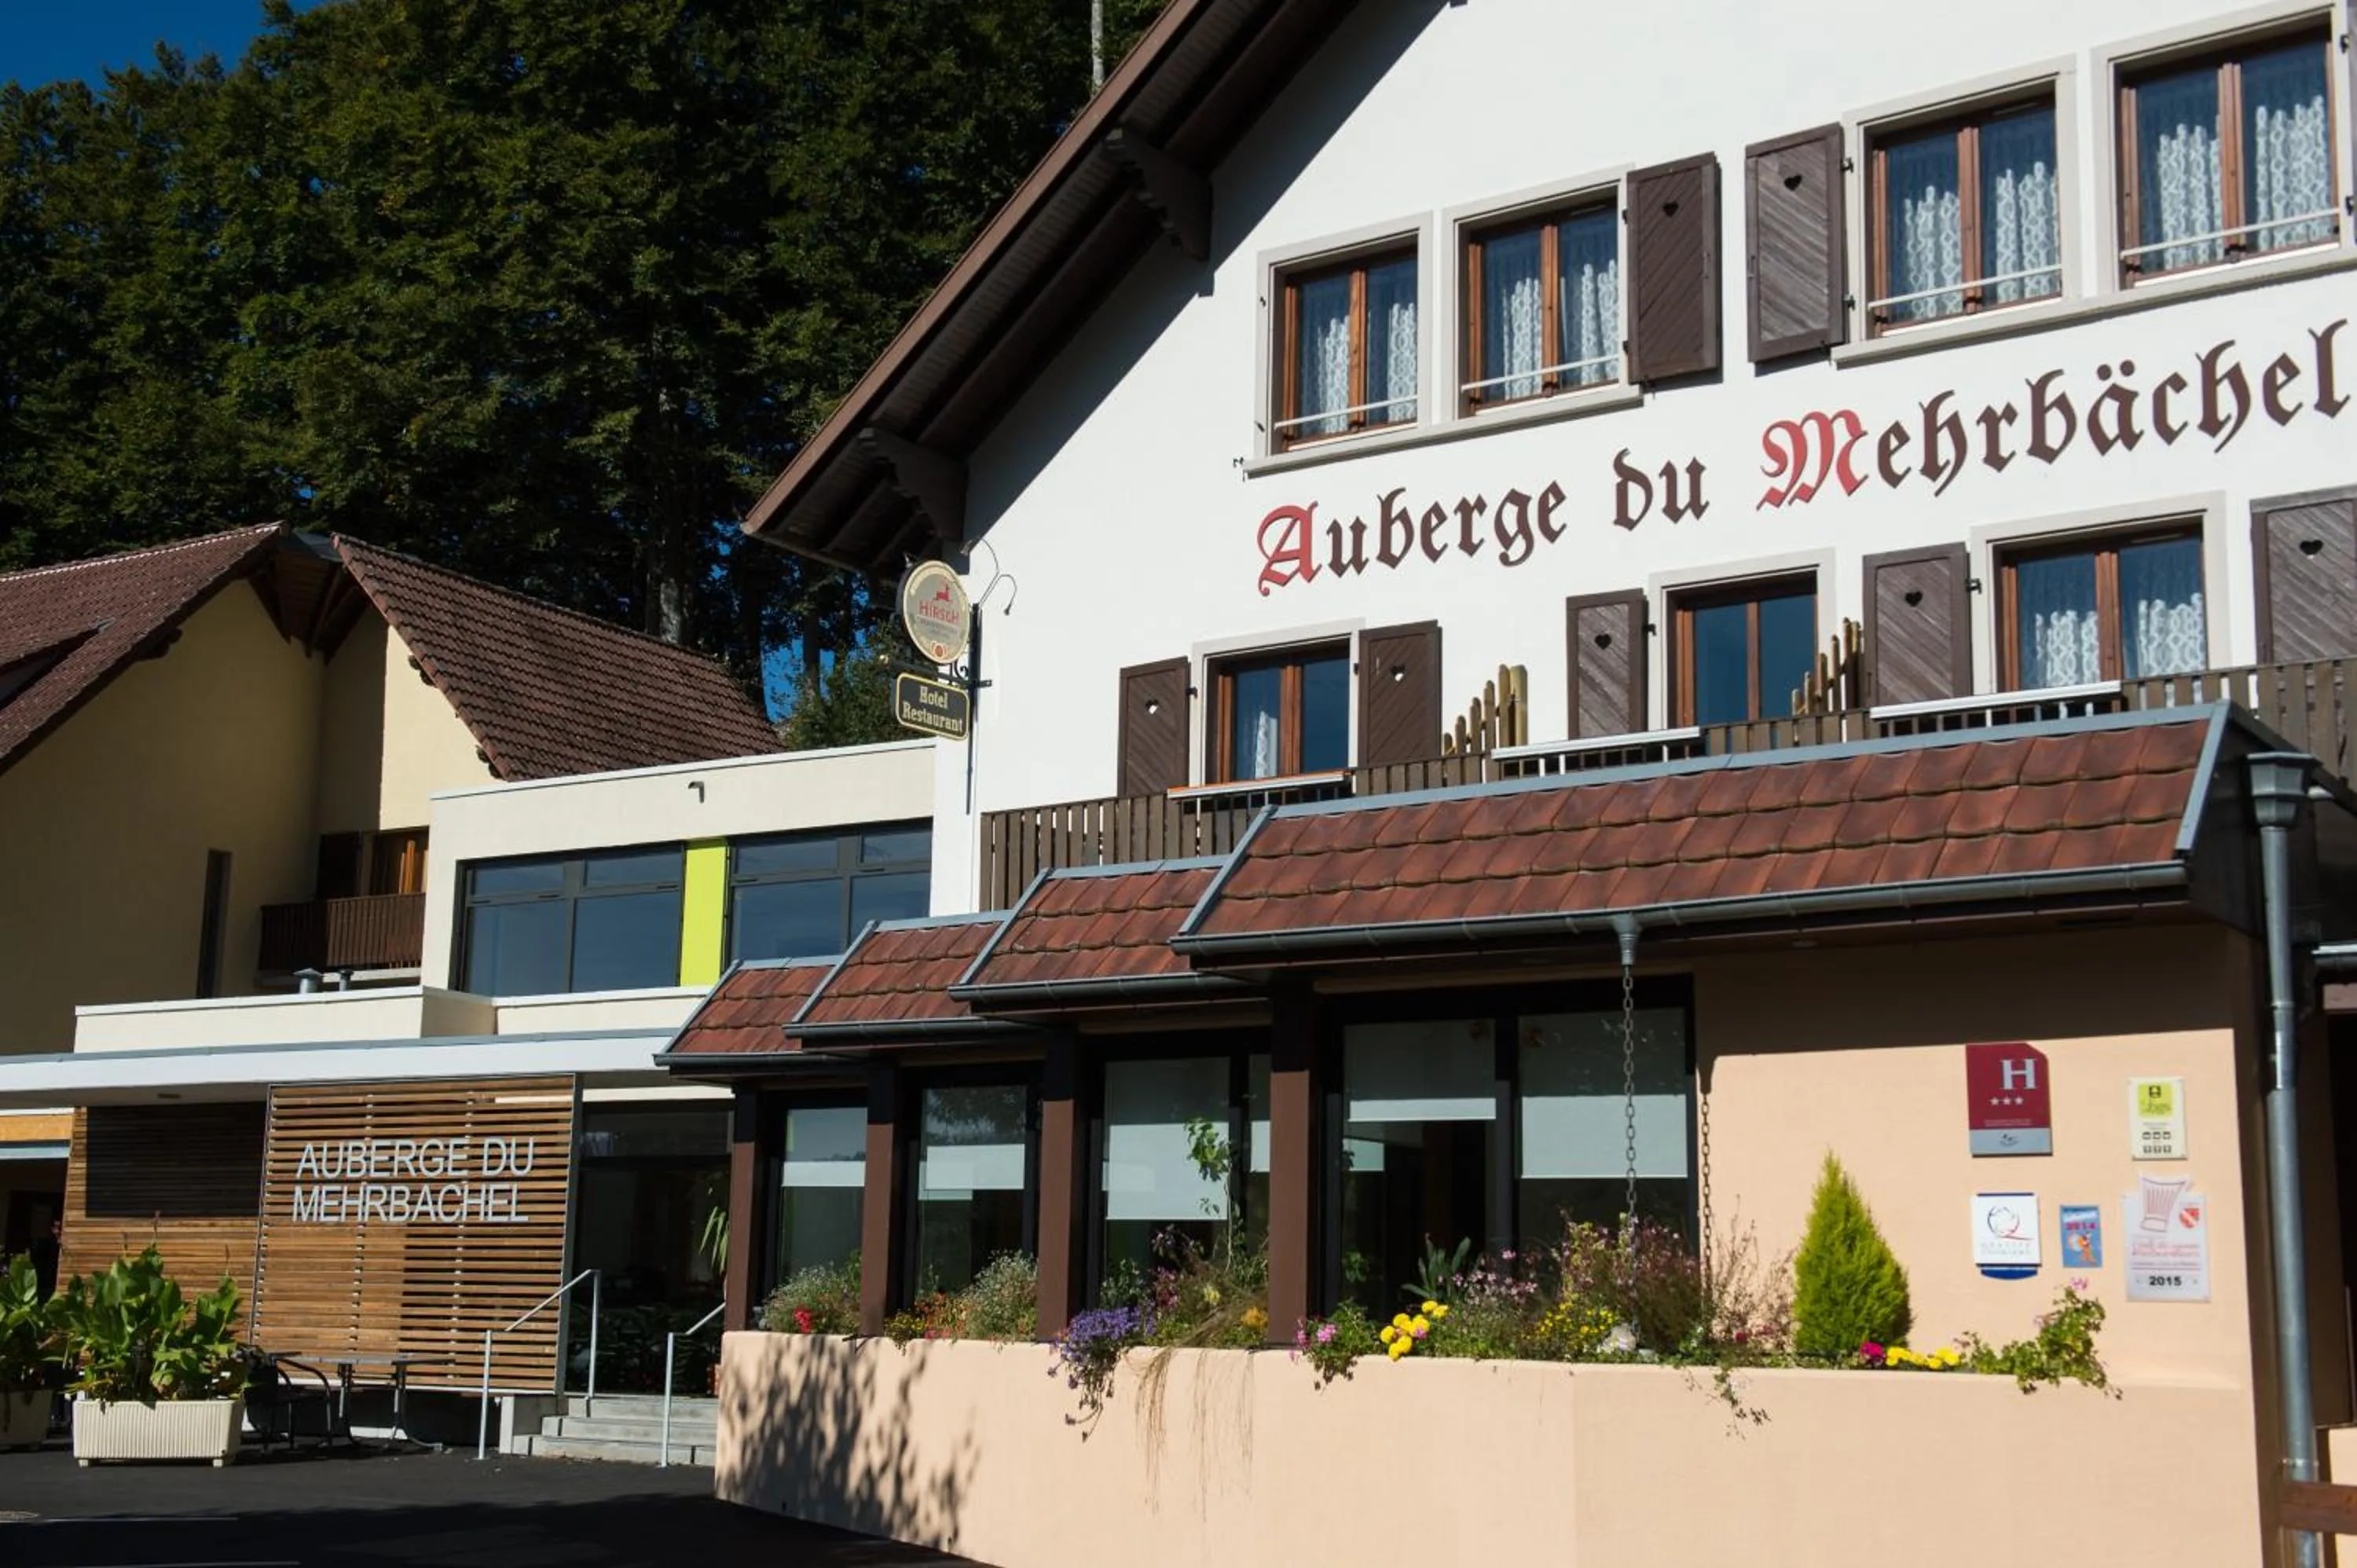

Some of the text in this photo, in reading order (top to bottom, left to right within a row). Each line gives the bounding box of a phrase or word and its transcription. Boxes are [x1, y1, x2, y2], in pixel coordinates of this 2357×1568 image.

[1257, 319, 2351, 596] Auberge du Mehrbächel
[919, 686, 948, 709] Hotel
[902, 702, 963, 732] Restaurant
[2000, 1058, 2038, 1090] H
[296, 1137, 534, 1178] AUBERGE DU
[291, 1183, 529, 1222] MEHRBACHEL
[2149, 1275, 2183, 1287] 2015
